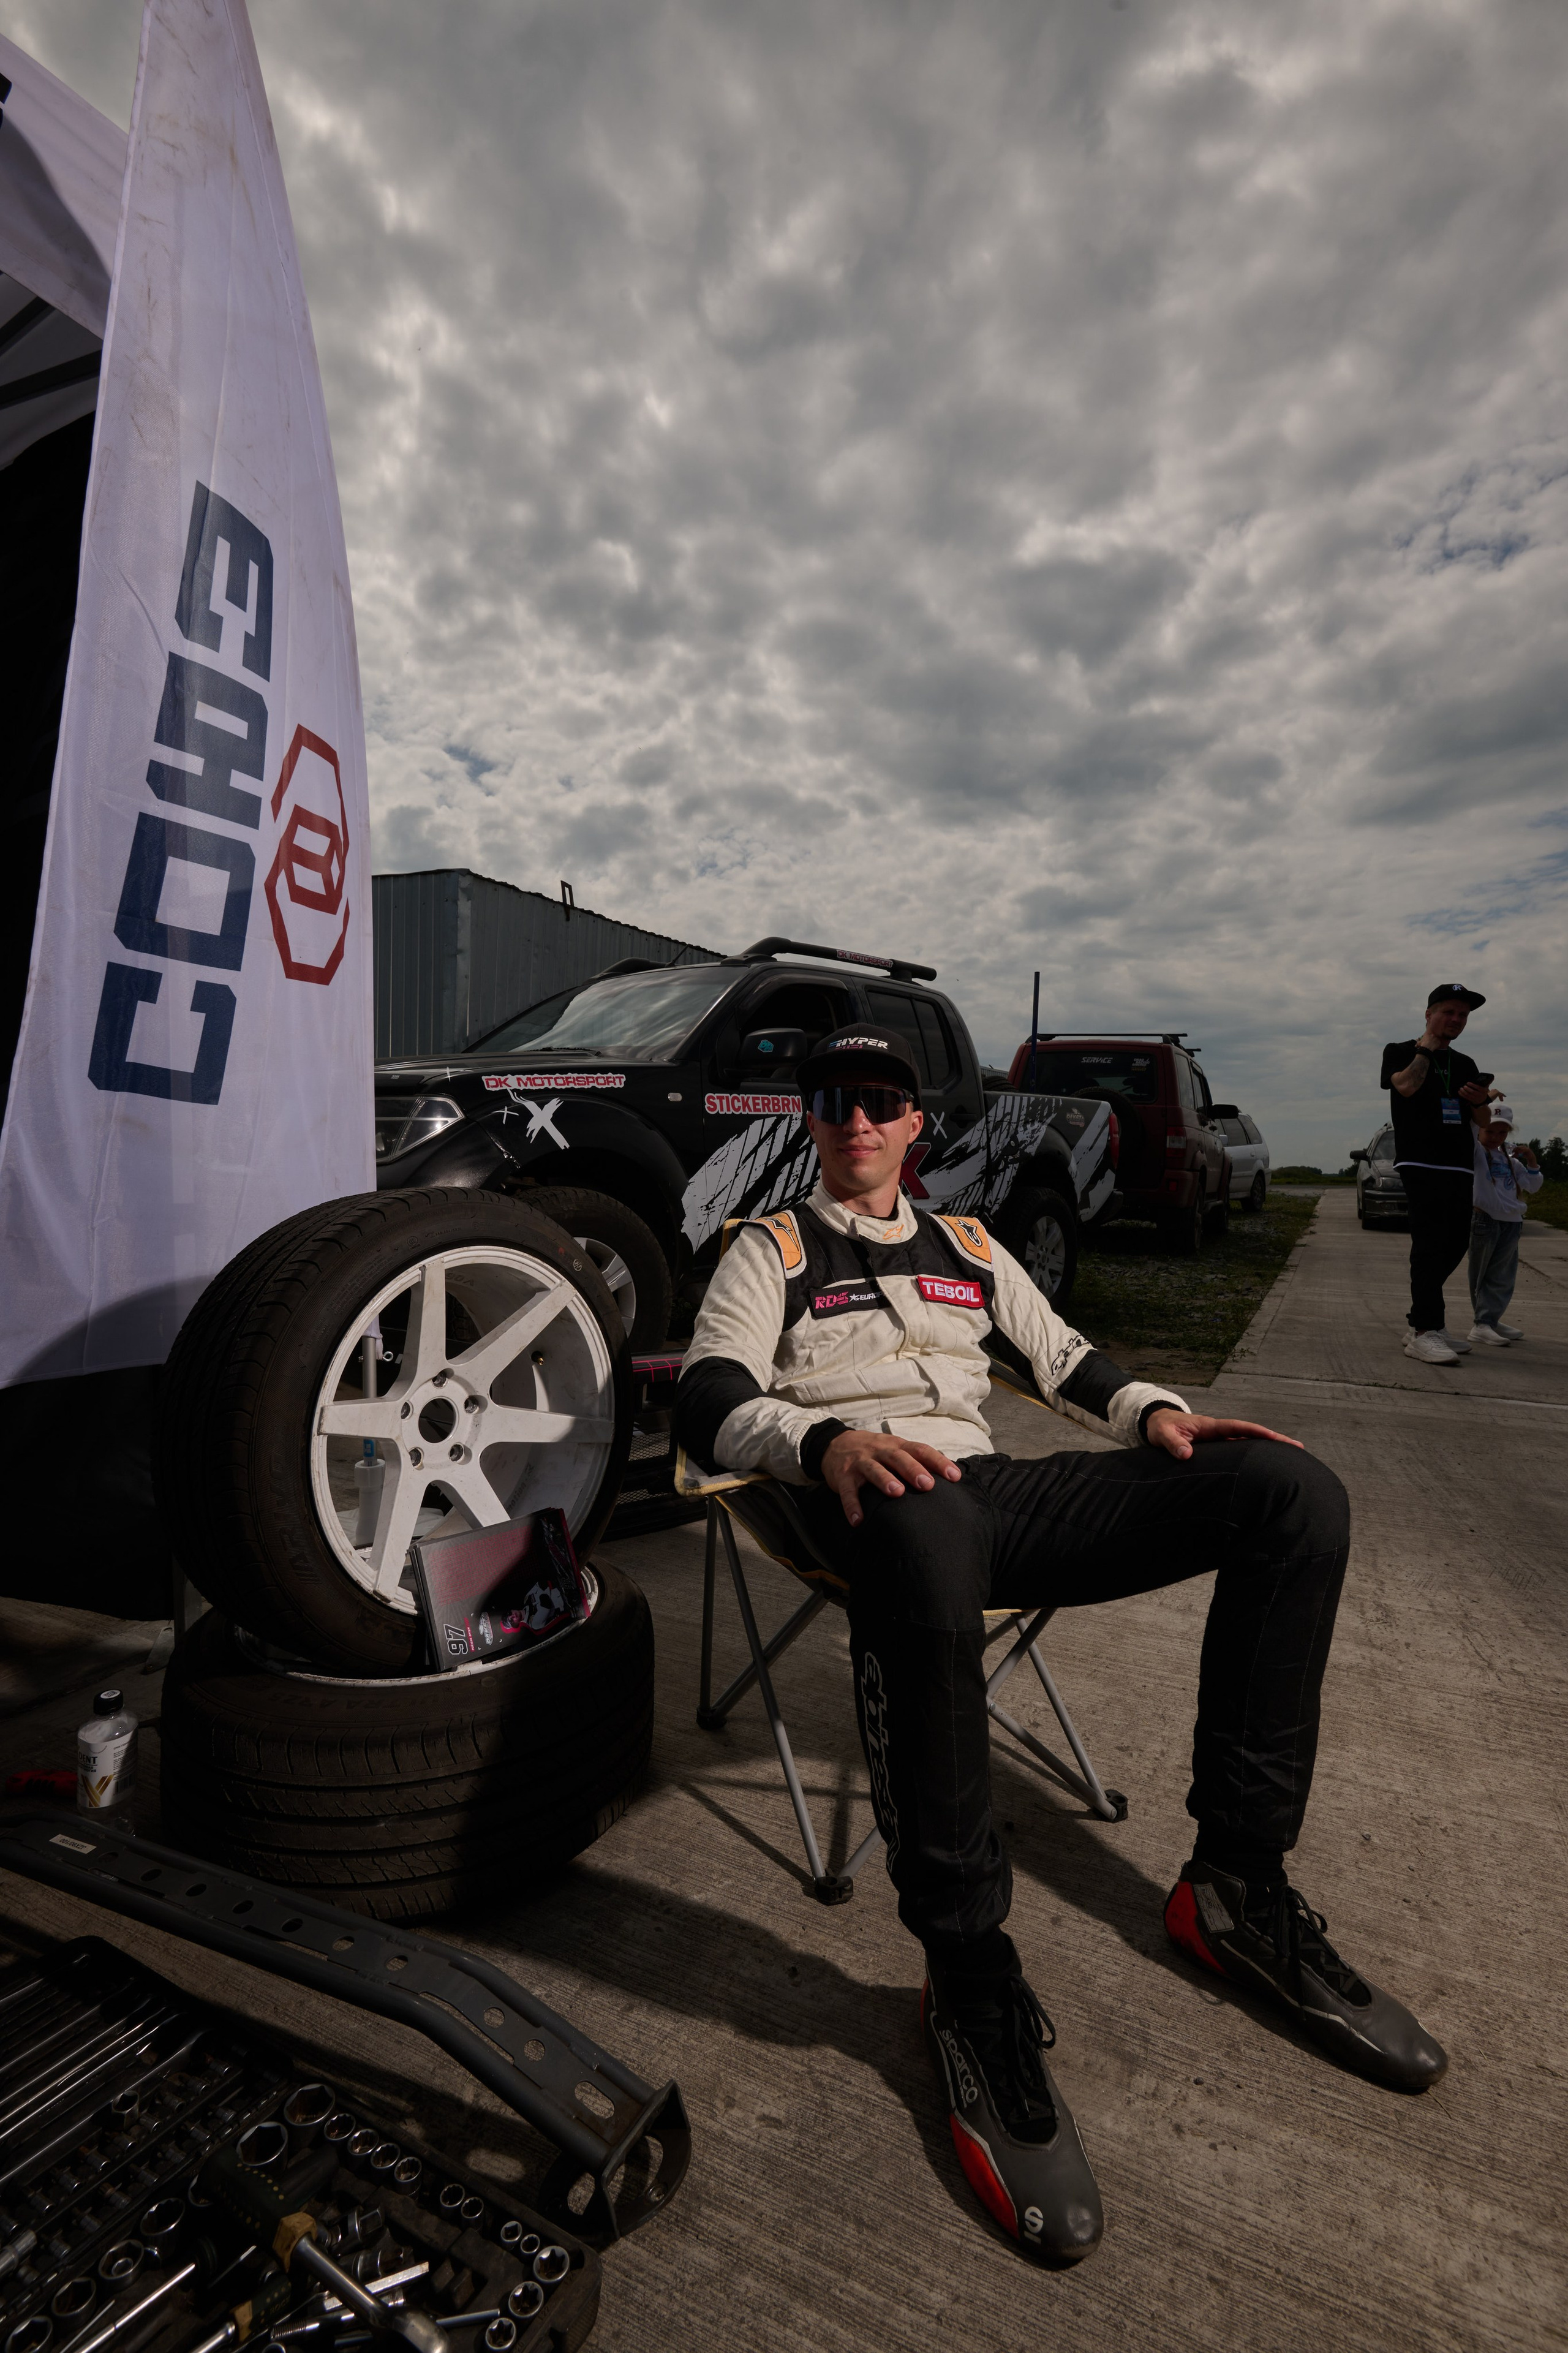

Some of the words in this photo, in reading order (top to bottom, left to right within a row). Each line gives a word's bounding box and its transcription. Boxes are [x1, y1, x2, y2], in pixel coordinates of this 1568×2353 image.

[88, 480, 274, 1105] СОЮЗ
[850, 953, 892, 967] MOTORSPORT
[832, 1037, 889, 1049] HYPER
[484, 1077, 511, 1088] DK
[516, 1076, 624, 1087] MOTORSPORT
[706, 1094, 801, 1112] STICKERBRN
[815, 1291, 850, 1309] RDS
[859, 1291, 885, 1301] EUROP
[922, 1281, 980, 1302] TEBOIL
[443, 1624, 469, 1655] 97
[942, 2028, 978, 2104] sparco
